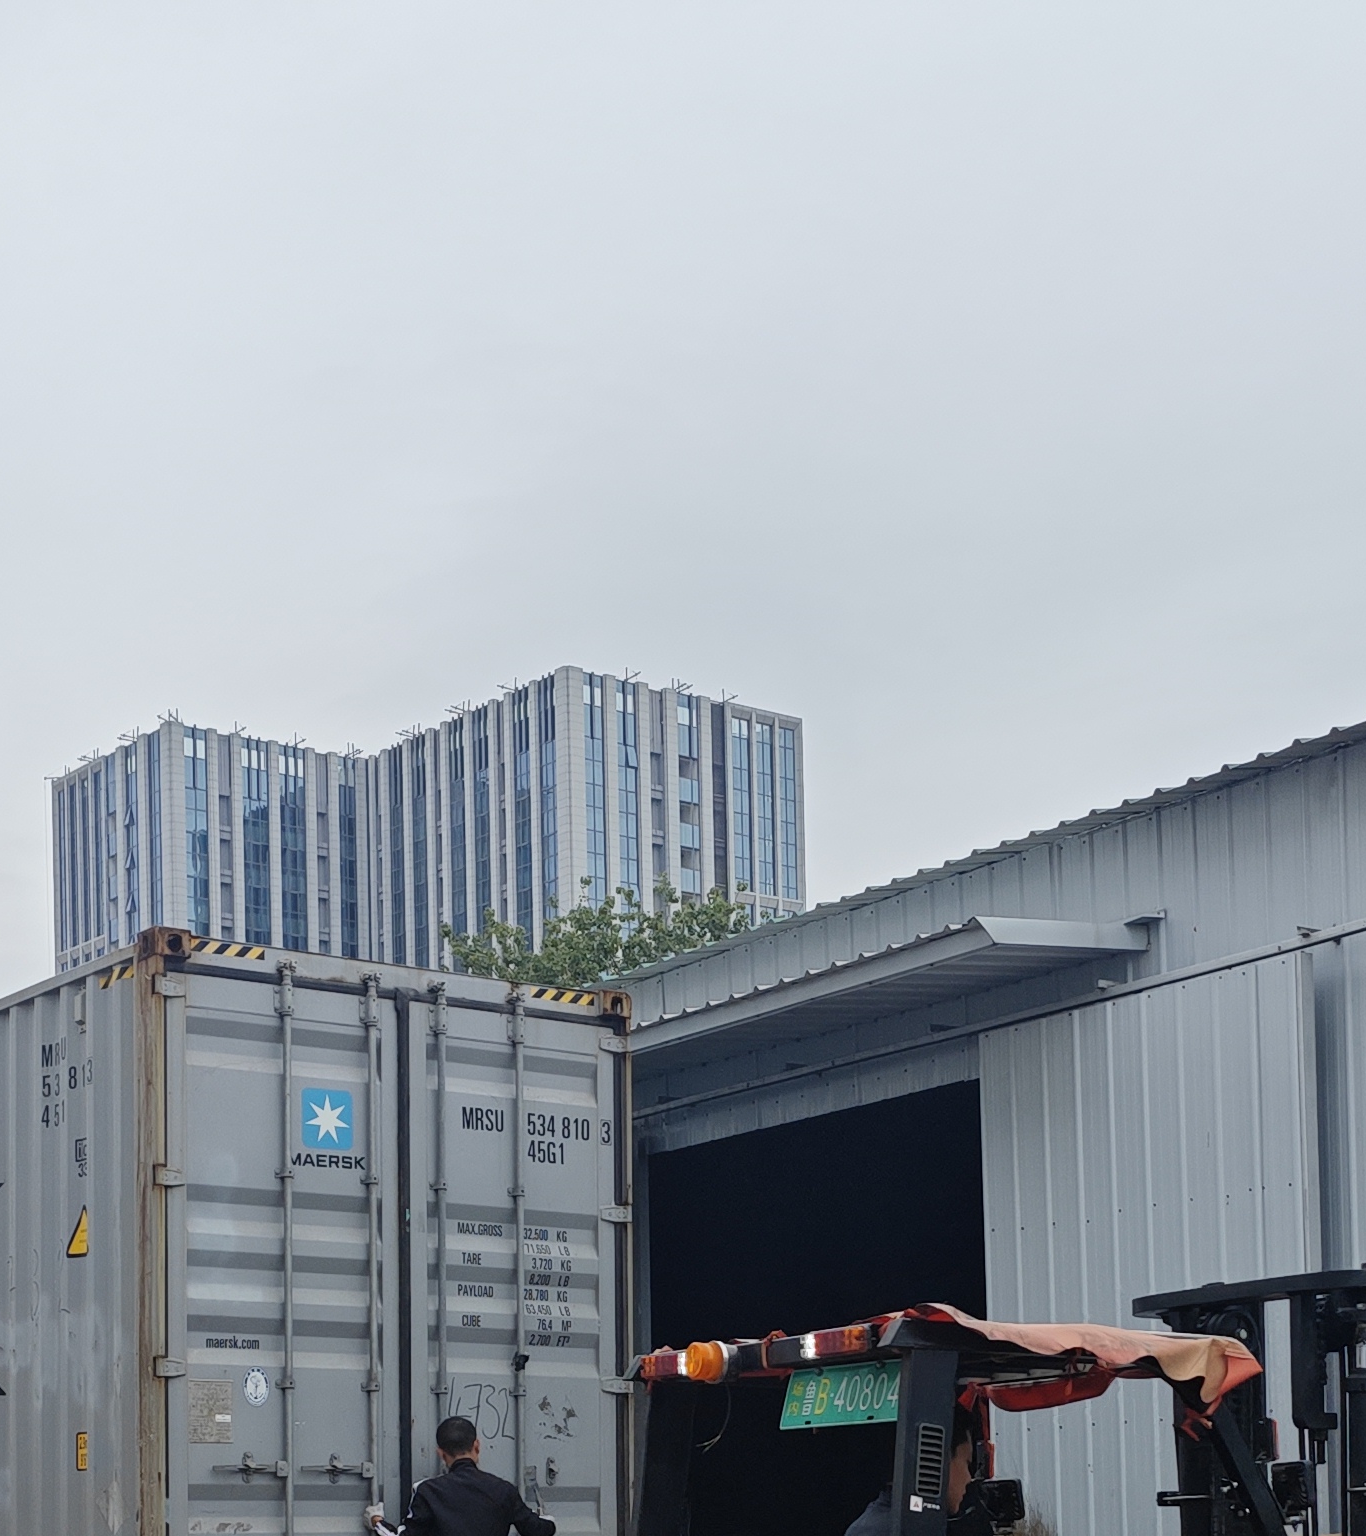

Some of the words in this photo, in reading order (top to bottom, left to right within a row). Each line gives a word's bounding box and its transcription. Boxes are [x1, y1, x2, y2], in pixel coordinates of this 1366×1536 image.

[462, 1106, 505, 1132] MRSU
[527, 1113, 556, 1138] 534
[562, 1117, 590, 1141] 810
[601, 1121, 611, 1144] 3
[527, 1139, 565, 1165] 45G1
[291, 1153, 366, 1171] MAERSK
[556, 1230, 567, 1242] KG
[558, 1246, 570, 1256] LB
[462, 1252, 482, 1265] TARE
[560, 1260, 572, 1272] KG
[557, 1275, 570, 1287] LB
[457, 1284, 494, 1298] PAYLOAD
[556, 1291, 568, 1303] KG
[558, 1305, 571, 1317] LB
[462, 1314, 481, 1328] CUBE
[205, 1335, 260, 1350] maersk.com
